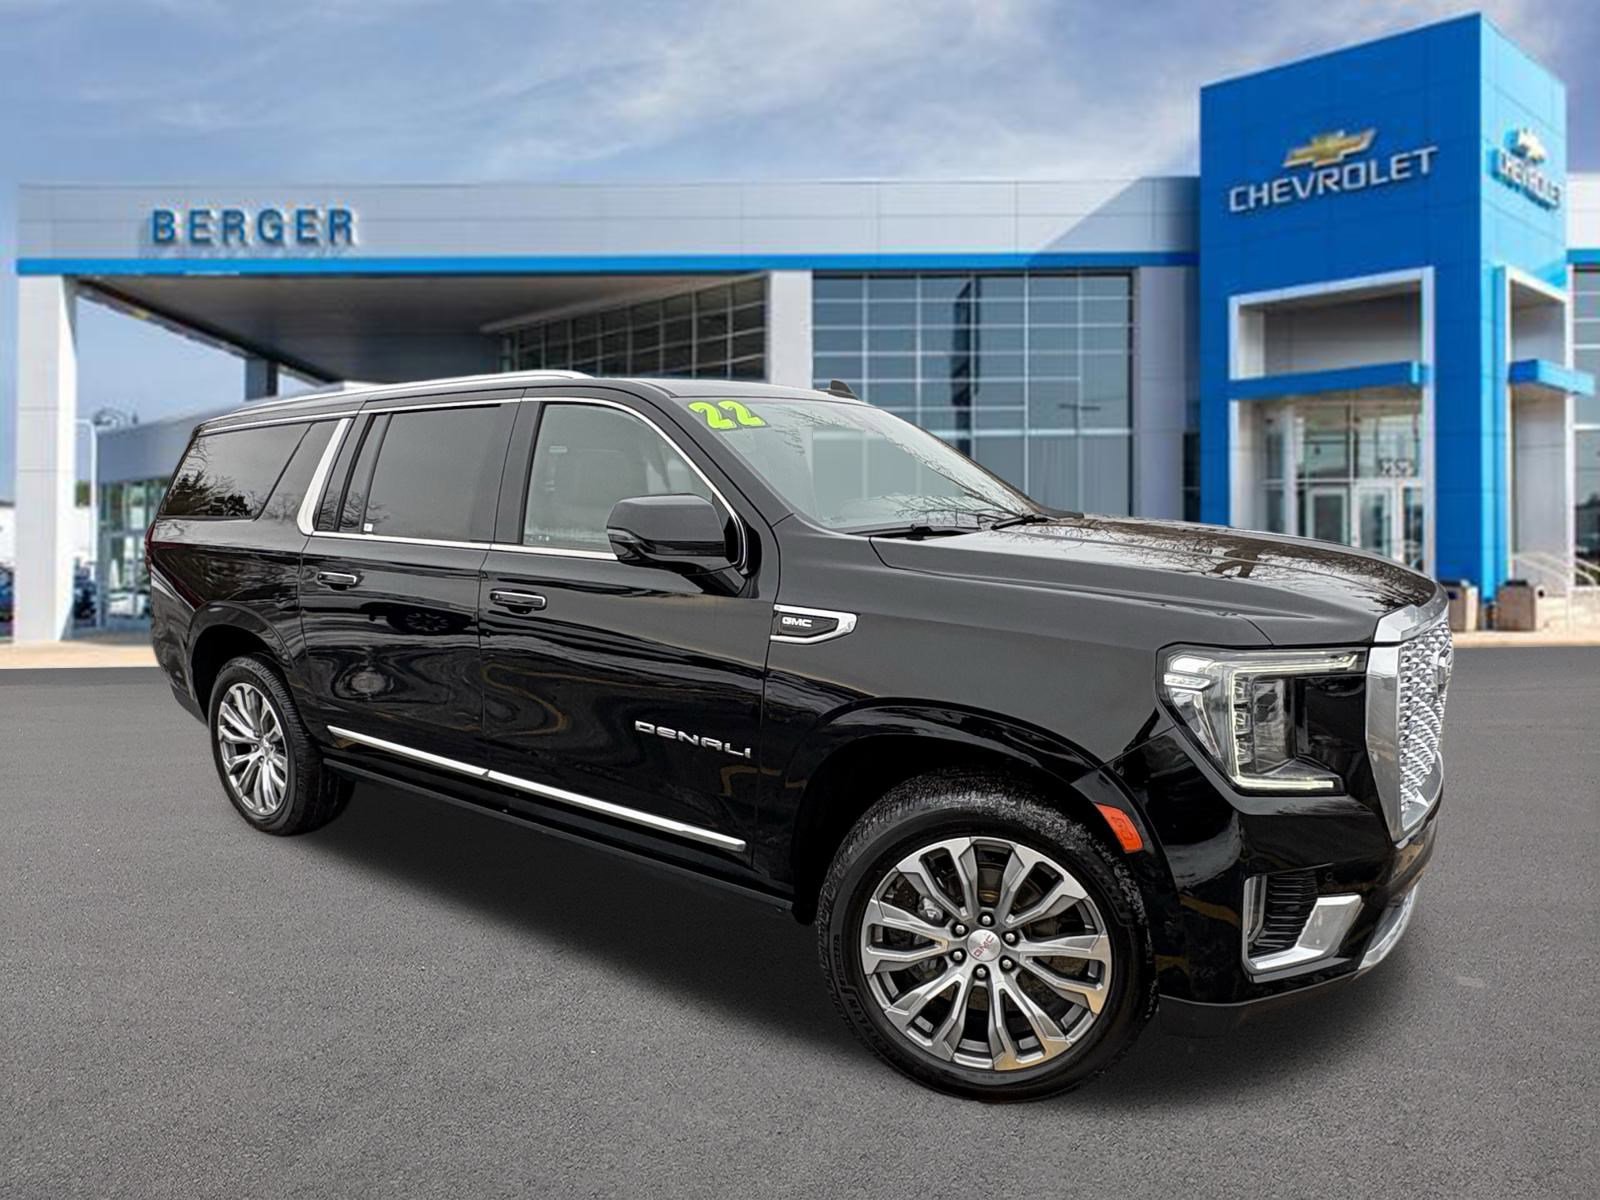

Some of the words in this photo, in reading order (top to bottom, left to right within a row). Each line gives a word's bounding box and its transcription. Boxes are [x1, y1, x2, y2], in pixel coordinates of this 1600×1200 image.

[1228, 146, 1438, 213] CHEVROLET
[151, 207, 356, 246] BERGER
[687, 400, 767, 430] 22
[781, 616, 813, 628] GMC
[634, 720, 752, 759] DENALI
[973, 934, 994, 957] GMC
